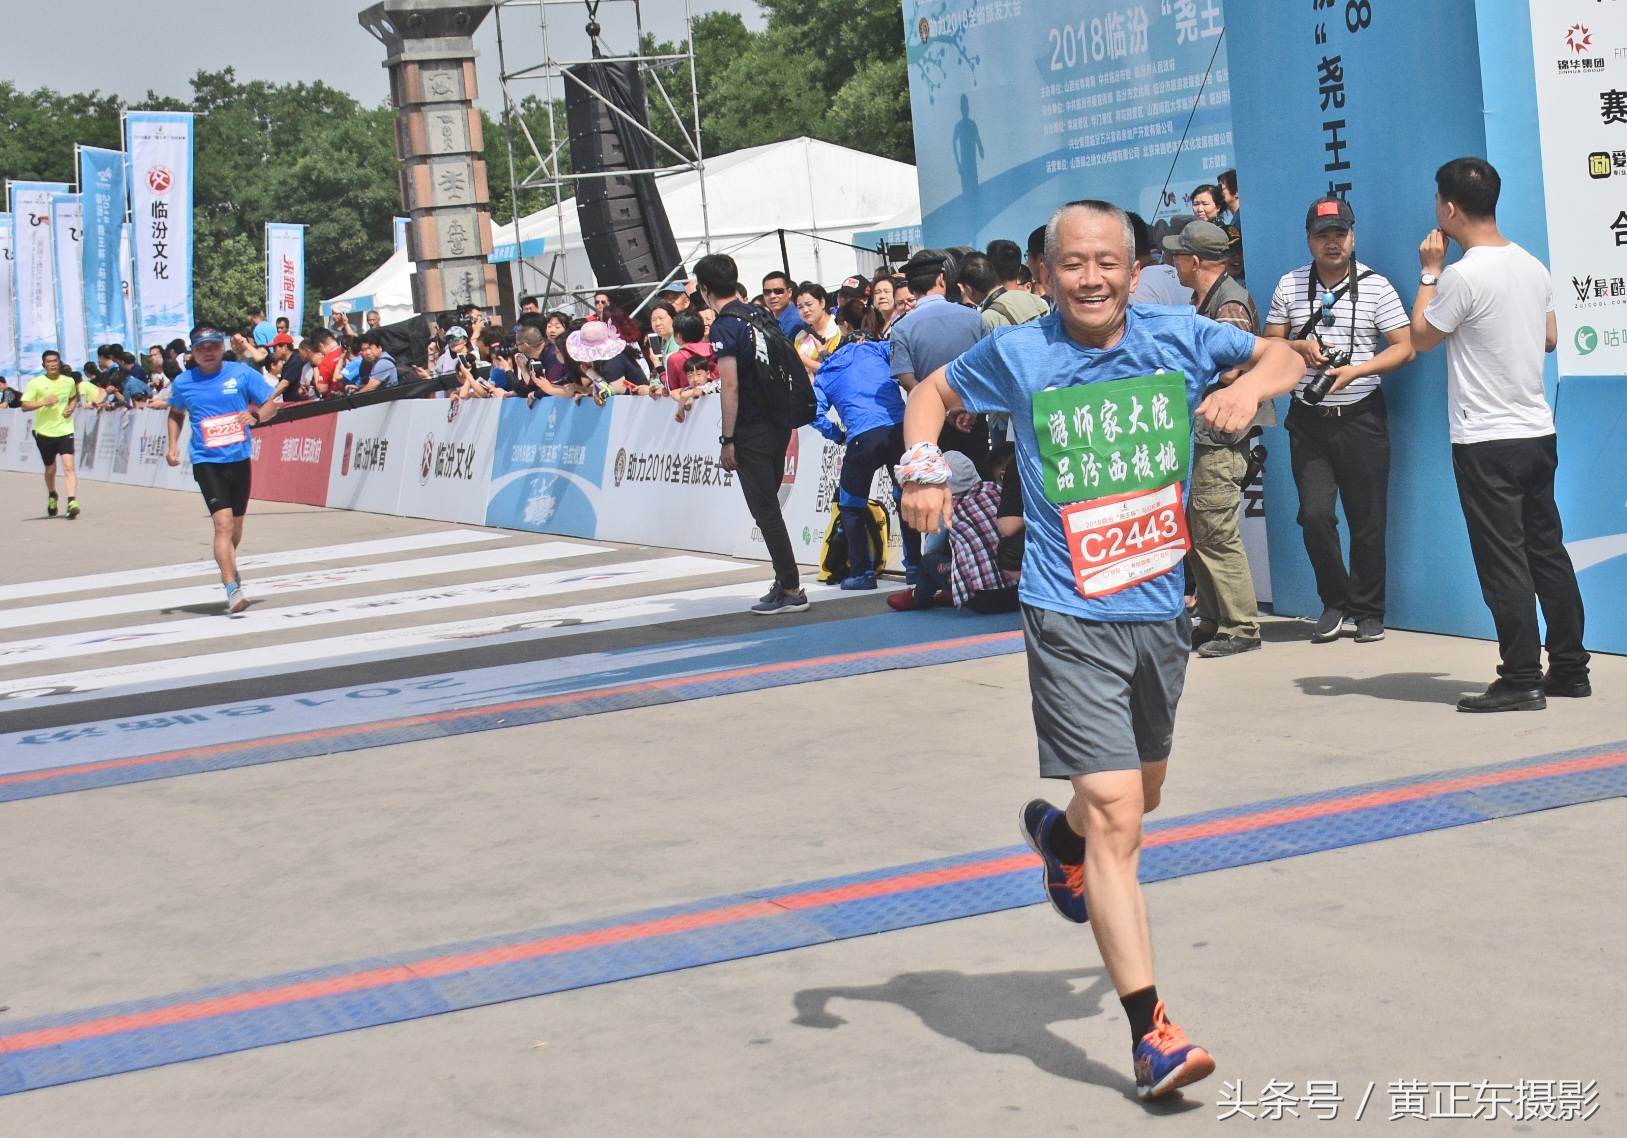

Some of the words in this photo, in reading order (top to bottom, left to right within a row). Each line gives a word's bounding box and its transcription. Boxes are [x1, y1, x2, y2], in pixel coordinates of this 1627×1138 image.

[1048, 5, 1149, 71] 2018临汾
[1557, 58, 1605, 70] 锦华集团
[151, 200, 169, 280] 临汾文化
[1593, 277, 1626, 298] 最酷
[207, 421, 242, 437] C2233
[353, 437, 389, 472] 临汾体育
[434, 441, 476, 480] 临汾文化
[1056, 441, 1179, 492] 品汾西核桃
[1080, 509, 1178, 562] C2443
